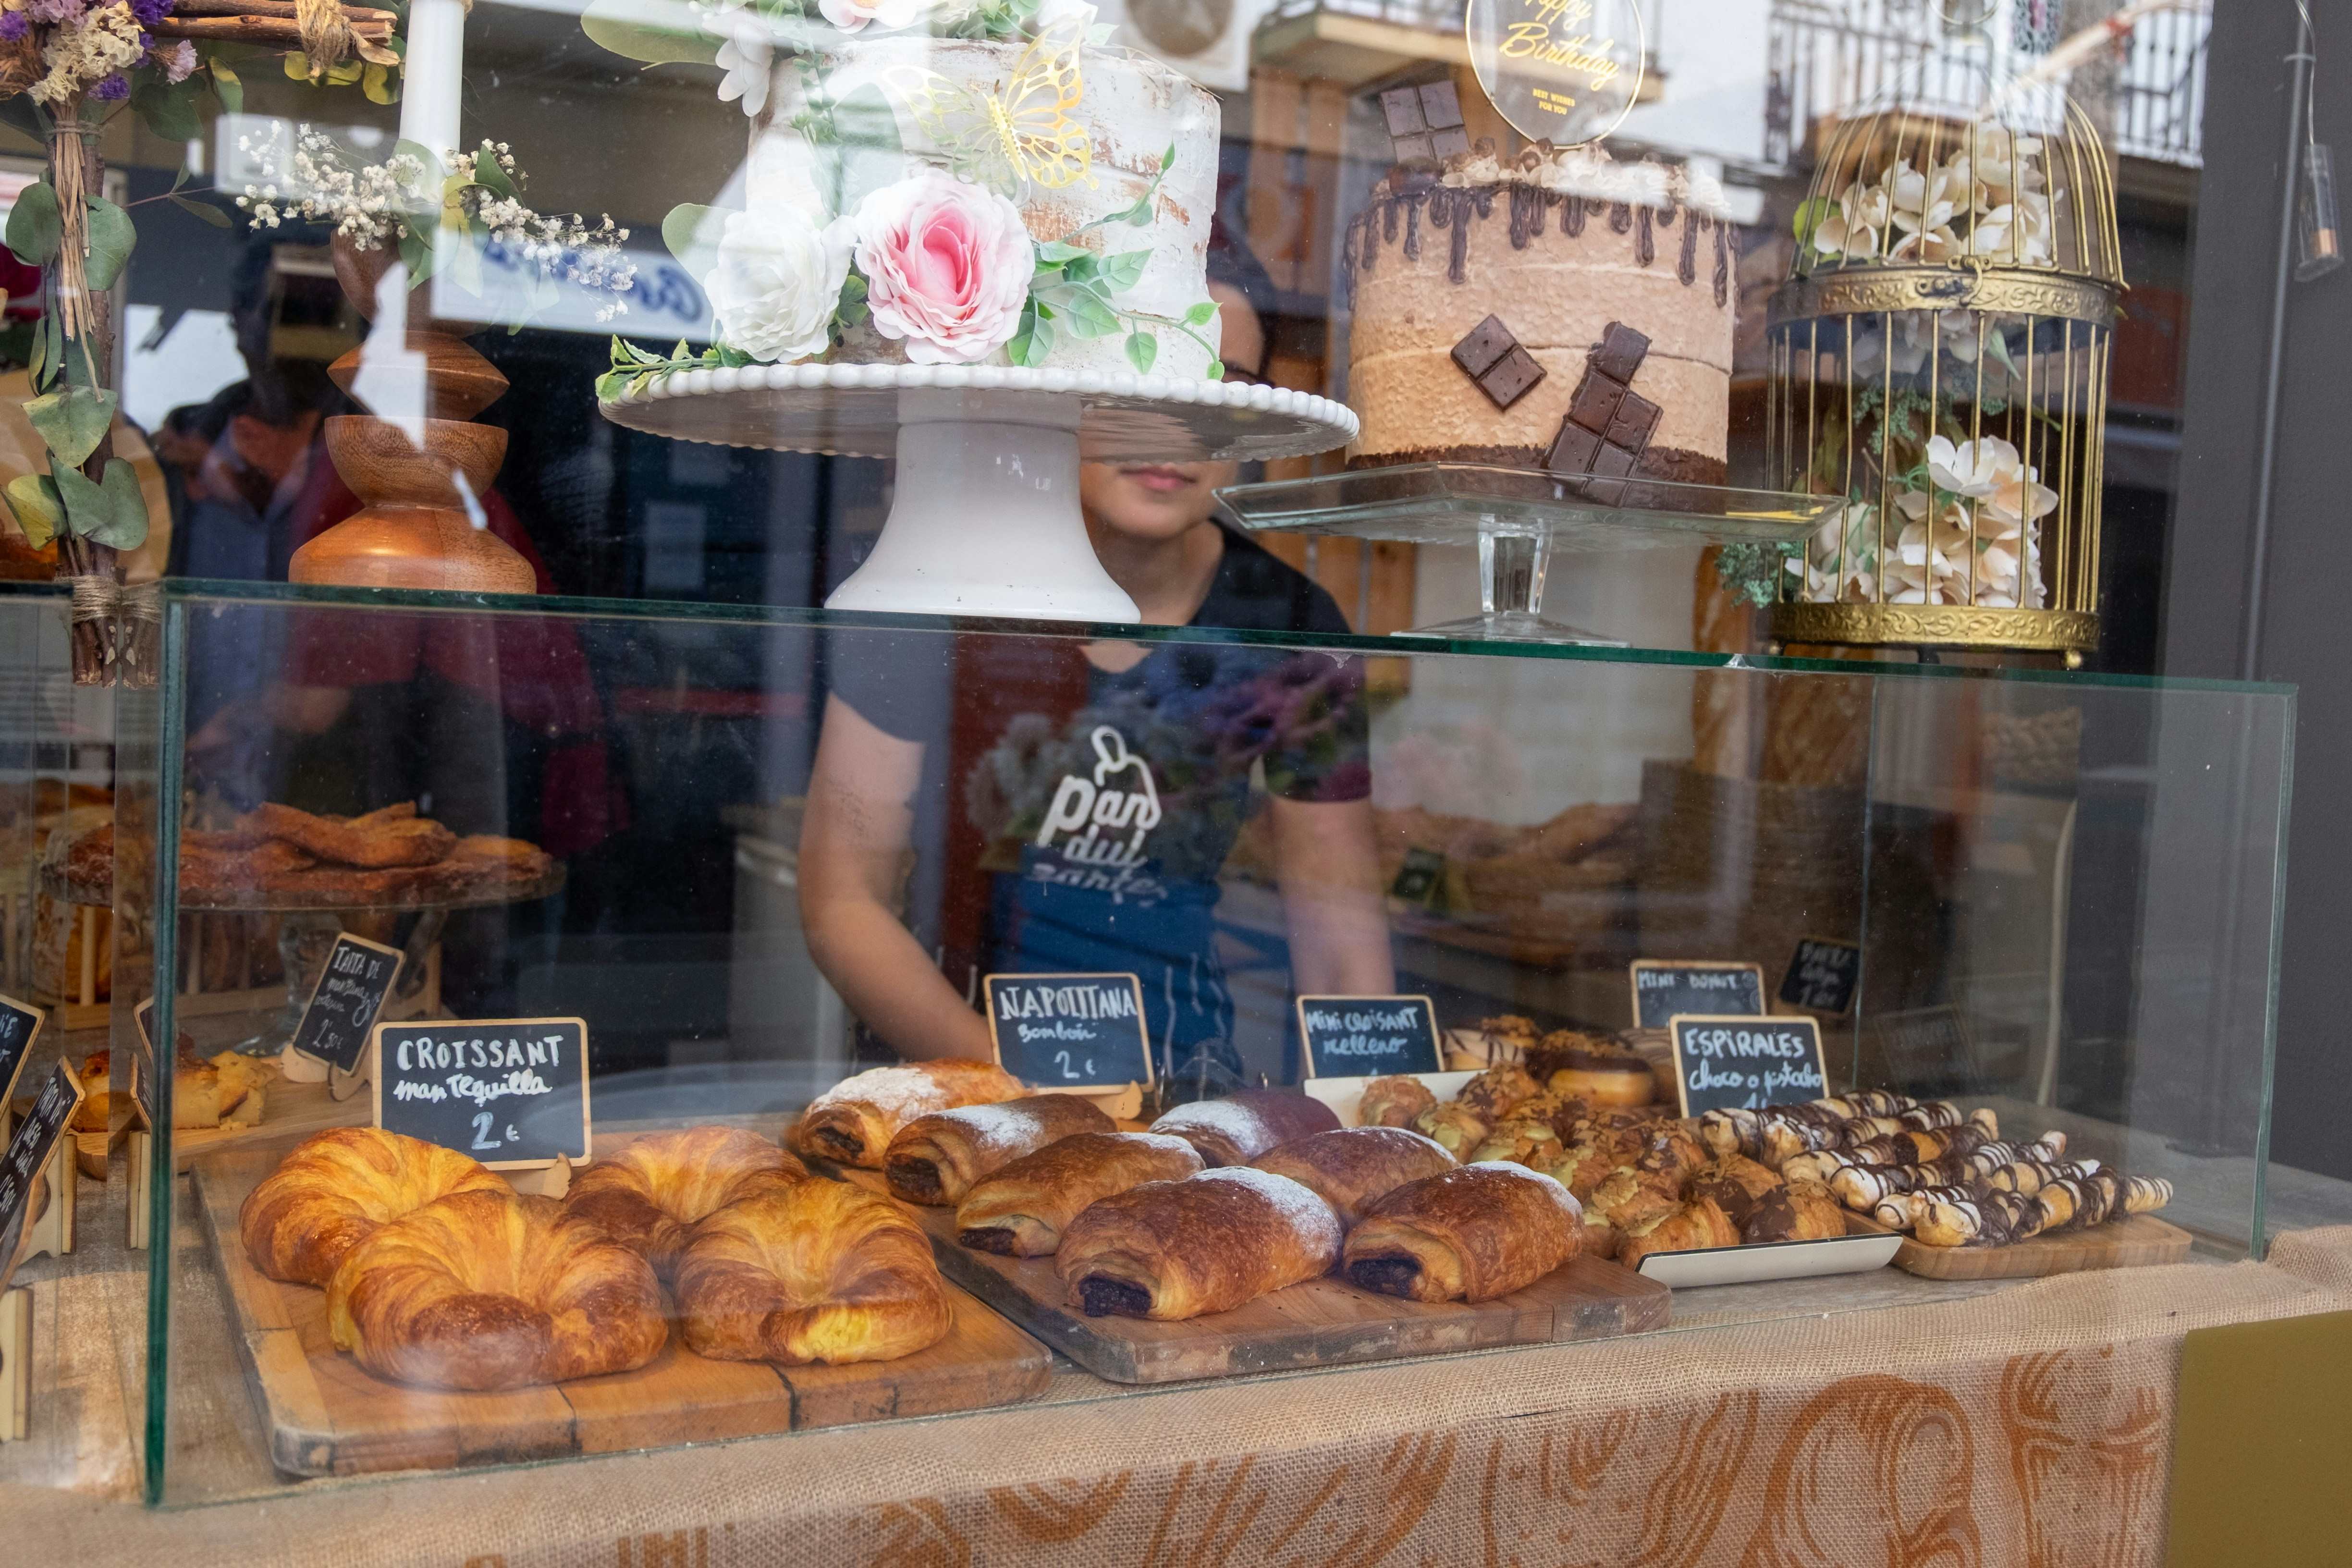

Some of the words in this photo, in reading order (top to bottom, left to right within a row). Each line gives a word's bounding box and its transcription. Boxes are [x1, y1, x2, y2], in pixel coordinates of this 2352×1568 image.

[1498, 22, 1619, 91] Birthday
[1532, 88, 1548, 99] BEST
[1551, 93, 1575, 107] WISHES
[1539, 101, 1552, 111] FOR
[1553, 104, 1567, 115] YOU
[999, 985, 1138, 1020] NAPOLITANA
[396, 1036, 564, 1071] CROISSANT
